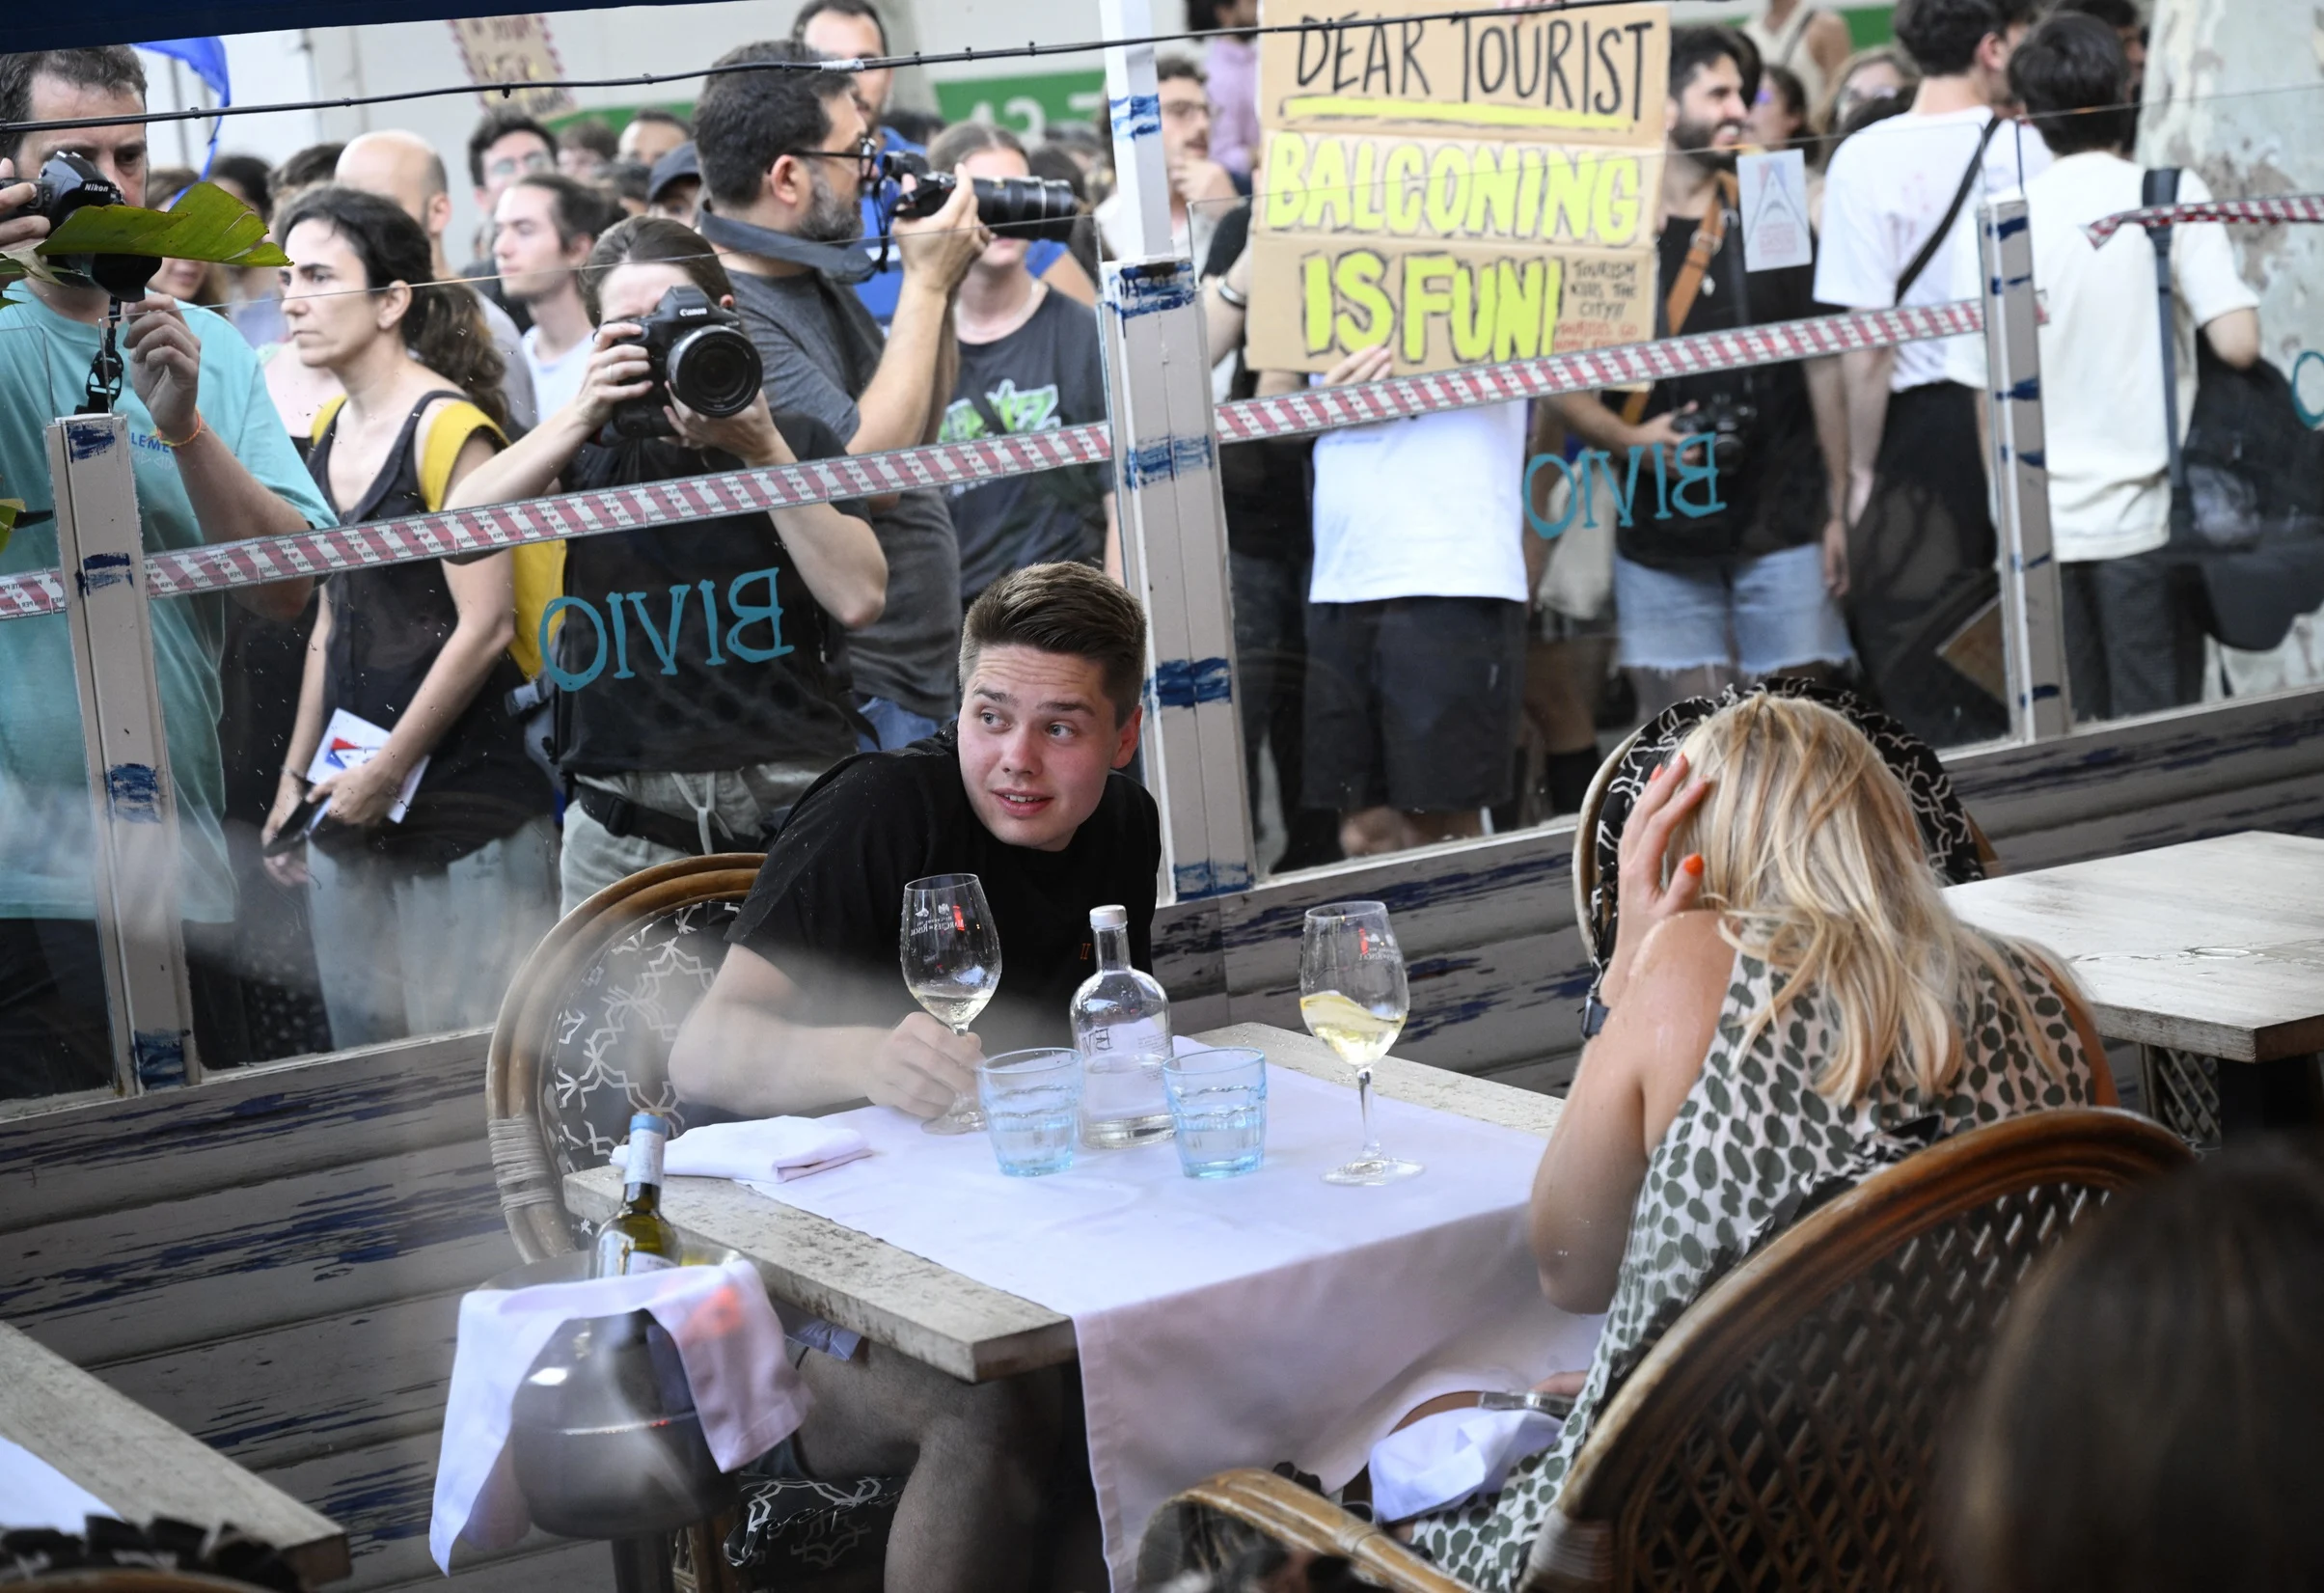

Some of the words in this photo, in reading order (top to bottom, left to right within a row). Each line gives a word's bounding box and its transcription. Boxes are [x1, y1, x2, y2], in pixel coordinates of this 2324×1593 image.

[1297, 13, 1432, 95] DEAR
[1450, 18, 1654, 122] TOURIST
[85, 182, 109, 192] Nikon
[1265, 130, 1645, 248] BALCONING
[679, 308, 707, 316] Canon
[1302, 249, 1395, 357] IS
